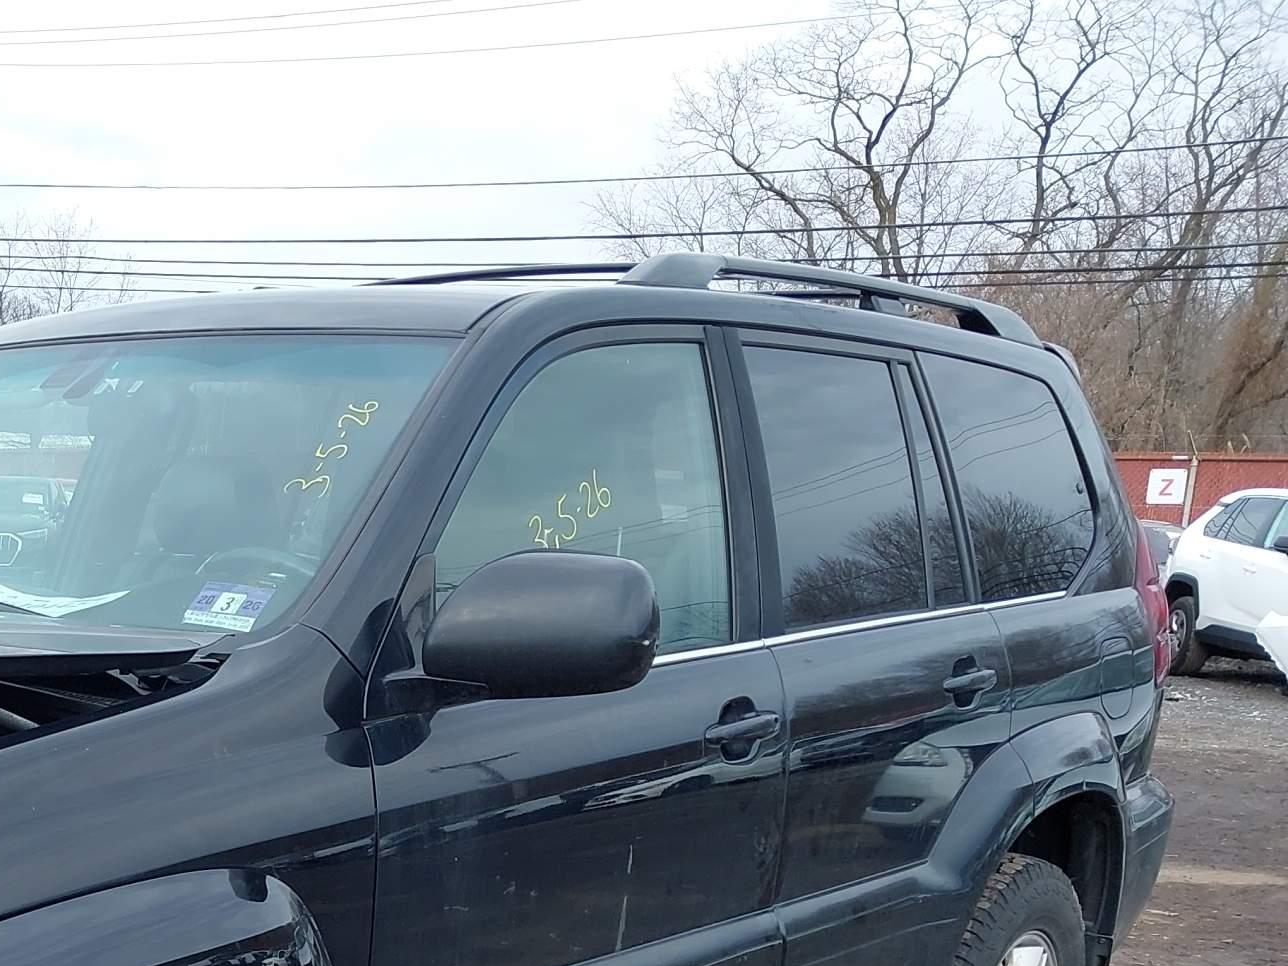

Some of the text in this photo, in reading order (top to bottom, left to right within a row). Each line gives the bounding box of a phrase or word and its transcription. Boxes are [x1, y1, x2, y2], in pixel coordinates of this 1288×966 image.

[284, 401, 378, 498] 3-5-26
[1158, 478, 1175, 496] Z
[197, 595, 215, 605] 20
[220, 597, 235, 611] 3
